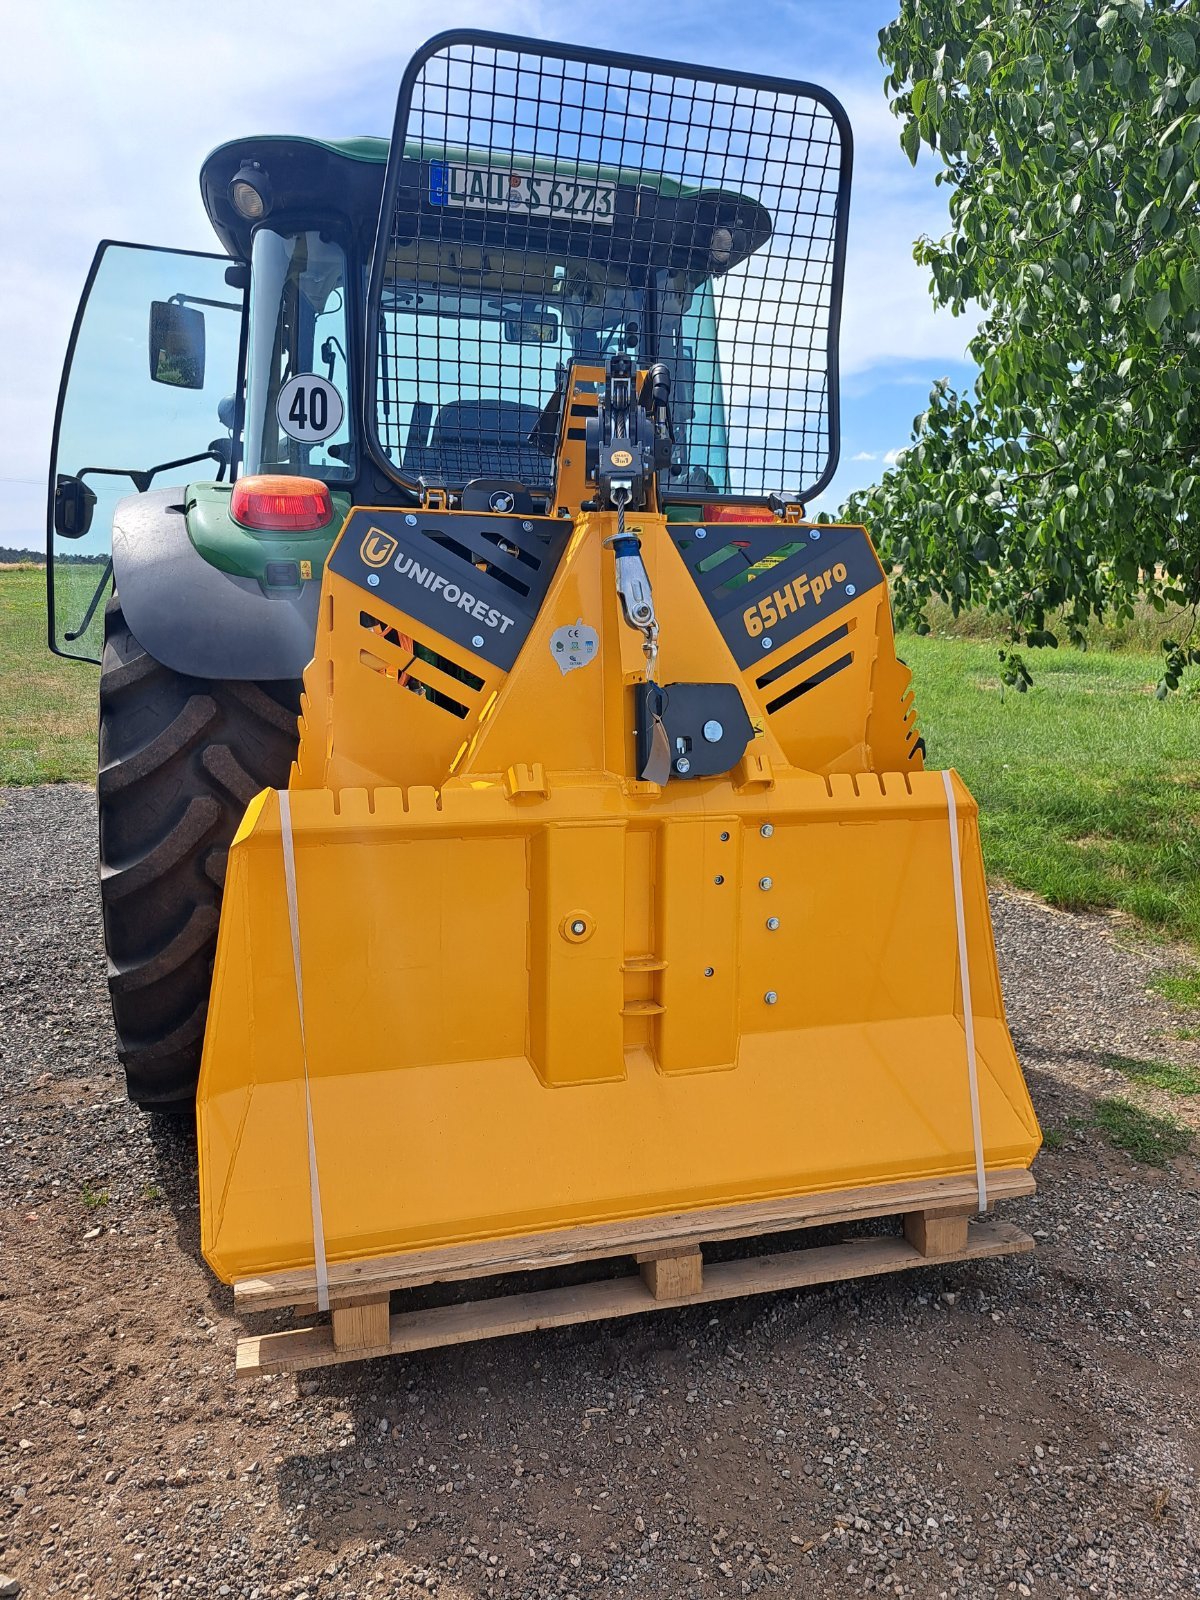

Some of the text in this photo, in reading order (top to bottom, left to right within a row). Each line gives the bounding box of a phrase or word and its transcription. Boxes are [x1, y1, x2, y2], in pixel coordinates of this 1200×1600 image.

[450, 167, 503, 206] LAU
[525, 178, 541, 209] S
[549, 182, 612, 218] 6273
[289, 387, 328, 431] 40
[394, 553, 515, 634] UNIFOREST
[743, 563, 847, 637] 65HFpro
[568, 630, 579, 638] CE
